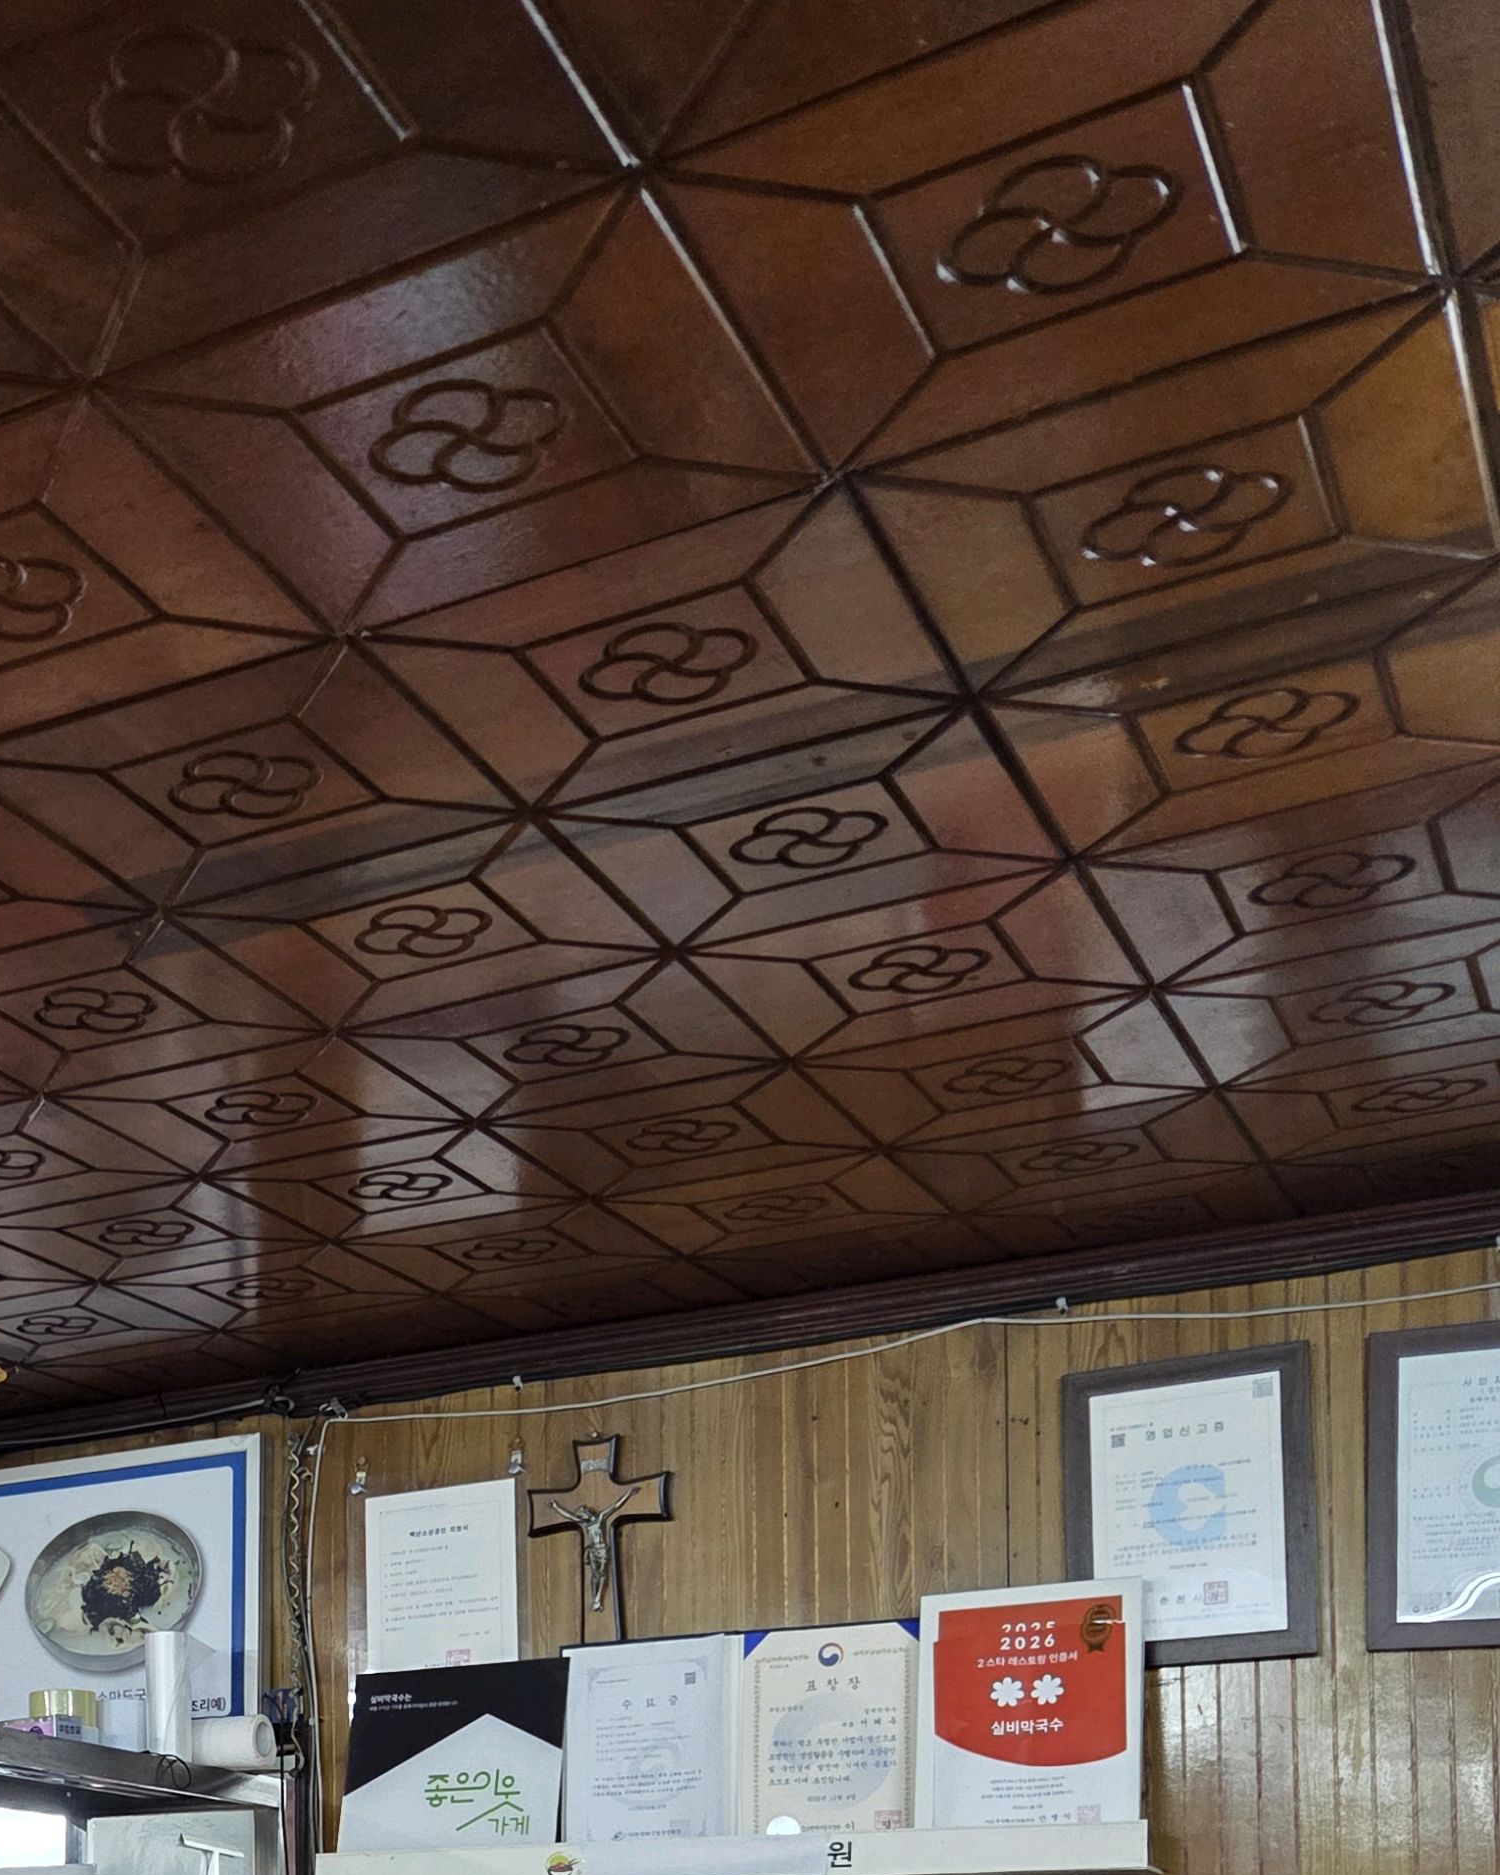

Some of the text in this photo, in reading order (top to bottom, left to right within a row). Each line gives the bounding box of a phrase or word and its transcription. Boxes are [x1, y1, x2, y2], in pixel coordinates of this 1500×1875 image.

[1000, 1634, 1055, 1650] 2026
[1008, 1653, 1046, 1666] 레스토랑
[1049, 1650, 1078, 1663] 인증서
[991, 1717, 1064, 1735] 실비막국수
[424, 1769, 525, 1829] 좋은이웃
[488, 1815, 530, 1836] 가게
[827, 1841, 852, 1868] 원
